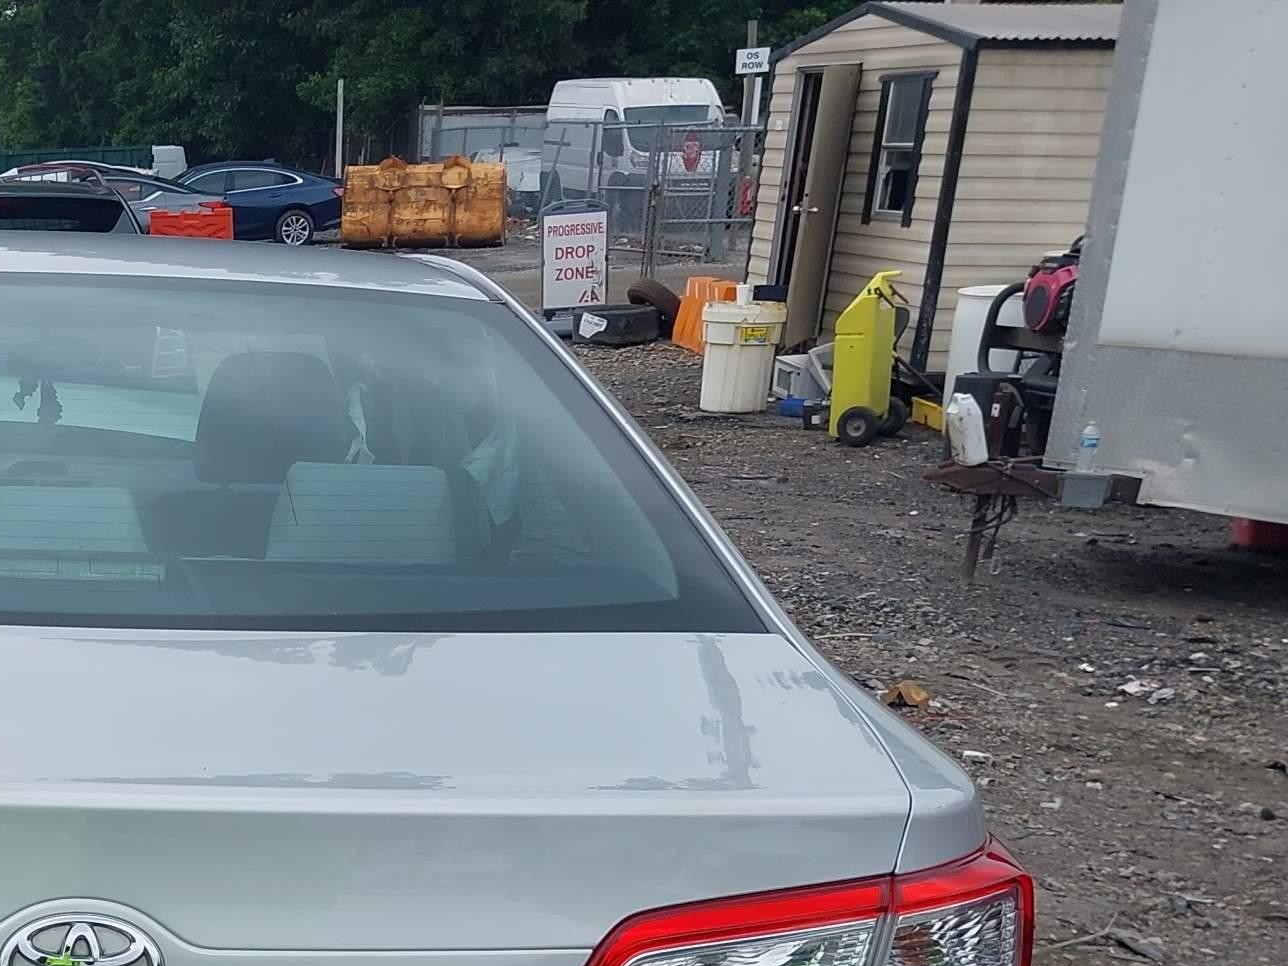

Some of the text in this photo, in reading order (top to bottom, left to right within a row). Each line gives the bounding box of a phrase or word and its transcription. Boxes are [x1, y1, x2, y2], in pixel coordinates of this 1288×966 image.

[746, 51, 760, 60] OS
[741, 61, 763, 70] ROW
[547, 222, 604, 238] PROGRESSIVE
[555, 245, 595, 260] DROP
[555, 265, 594, 281] ZONE
